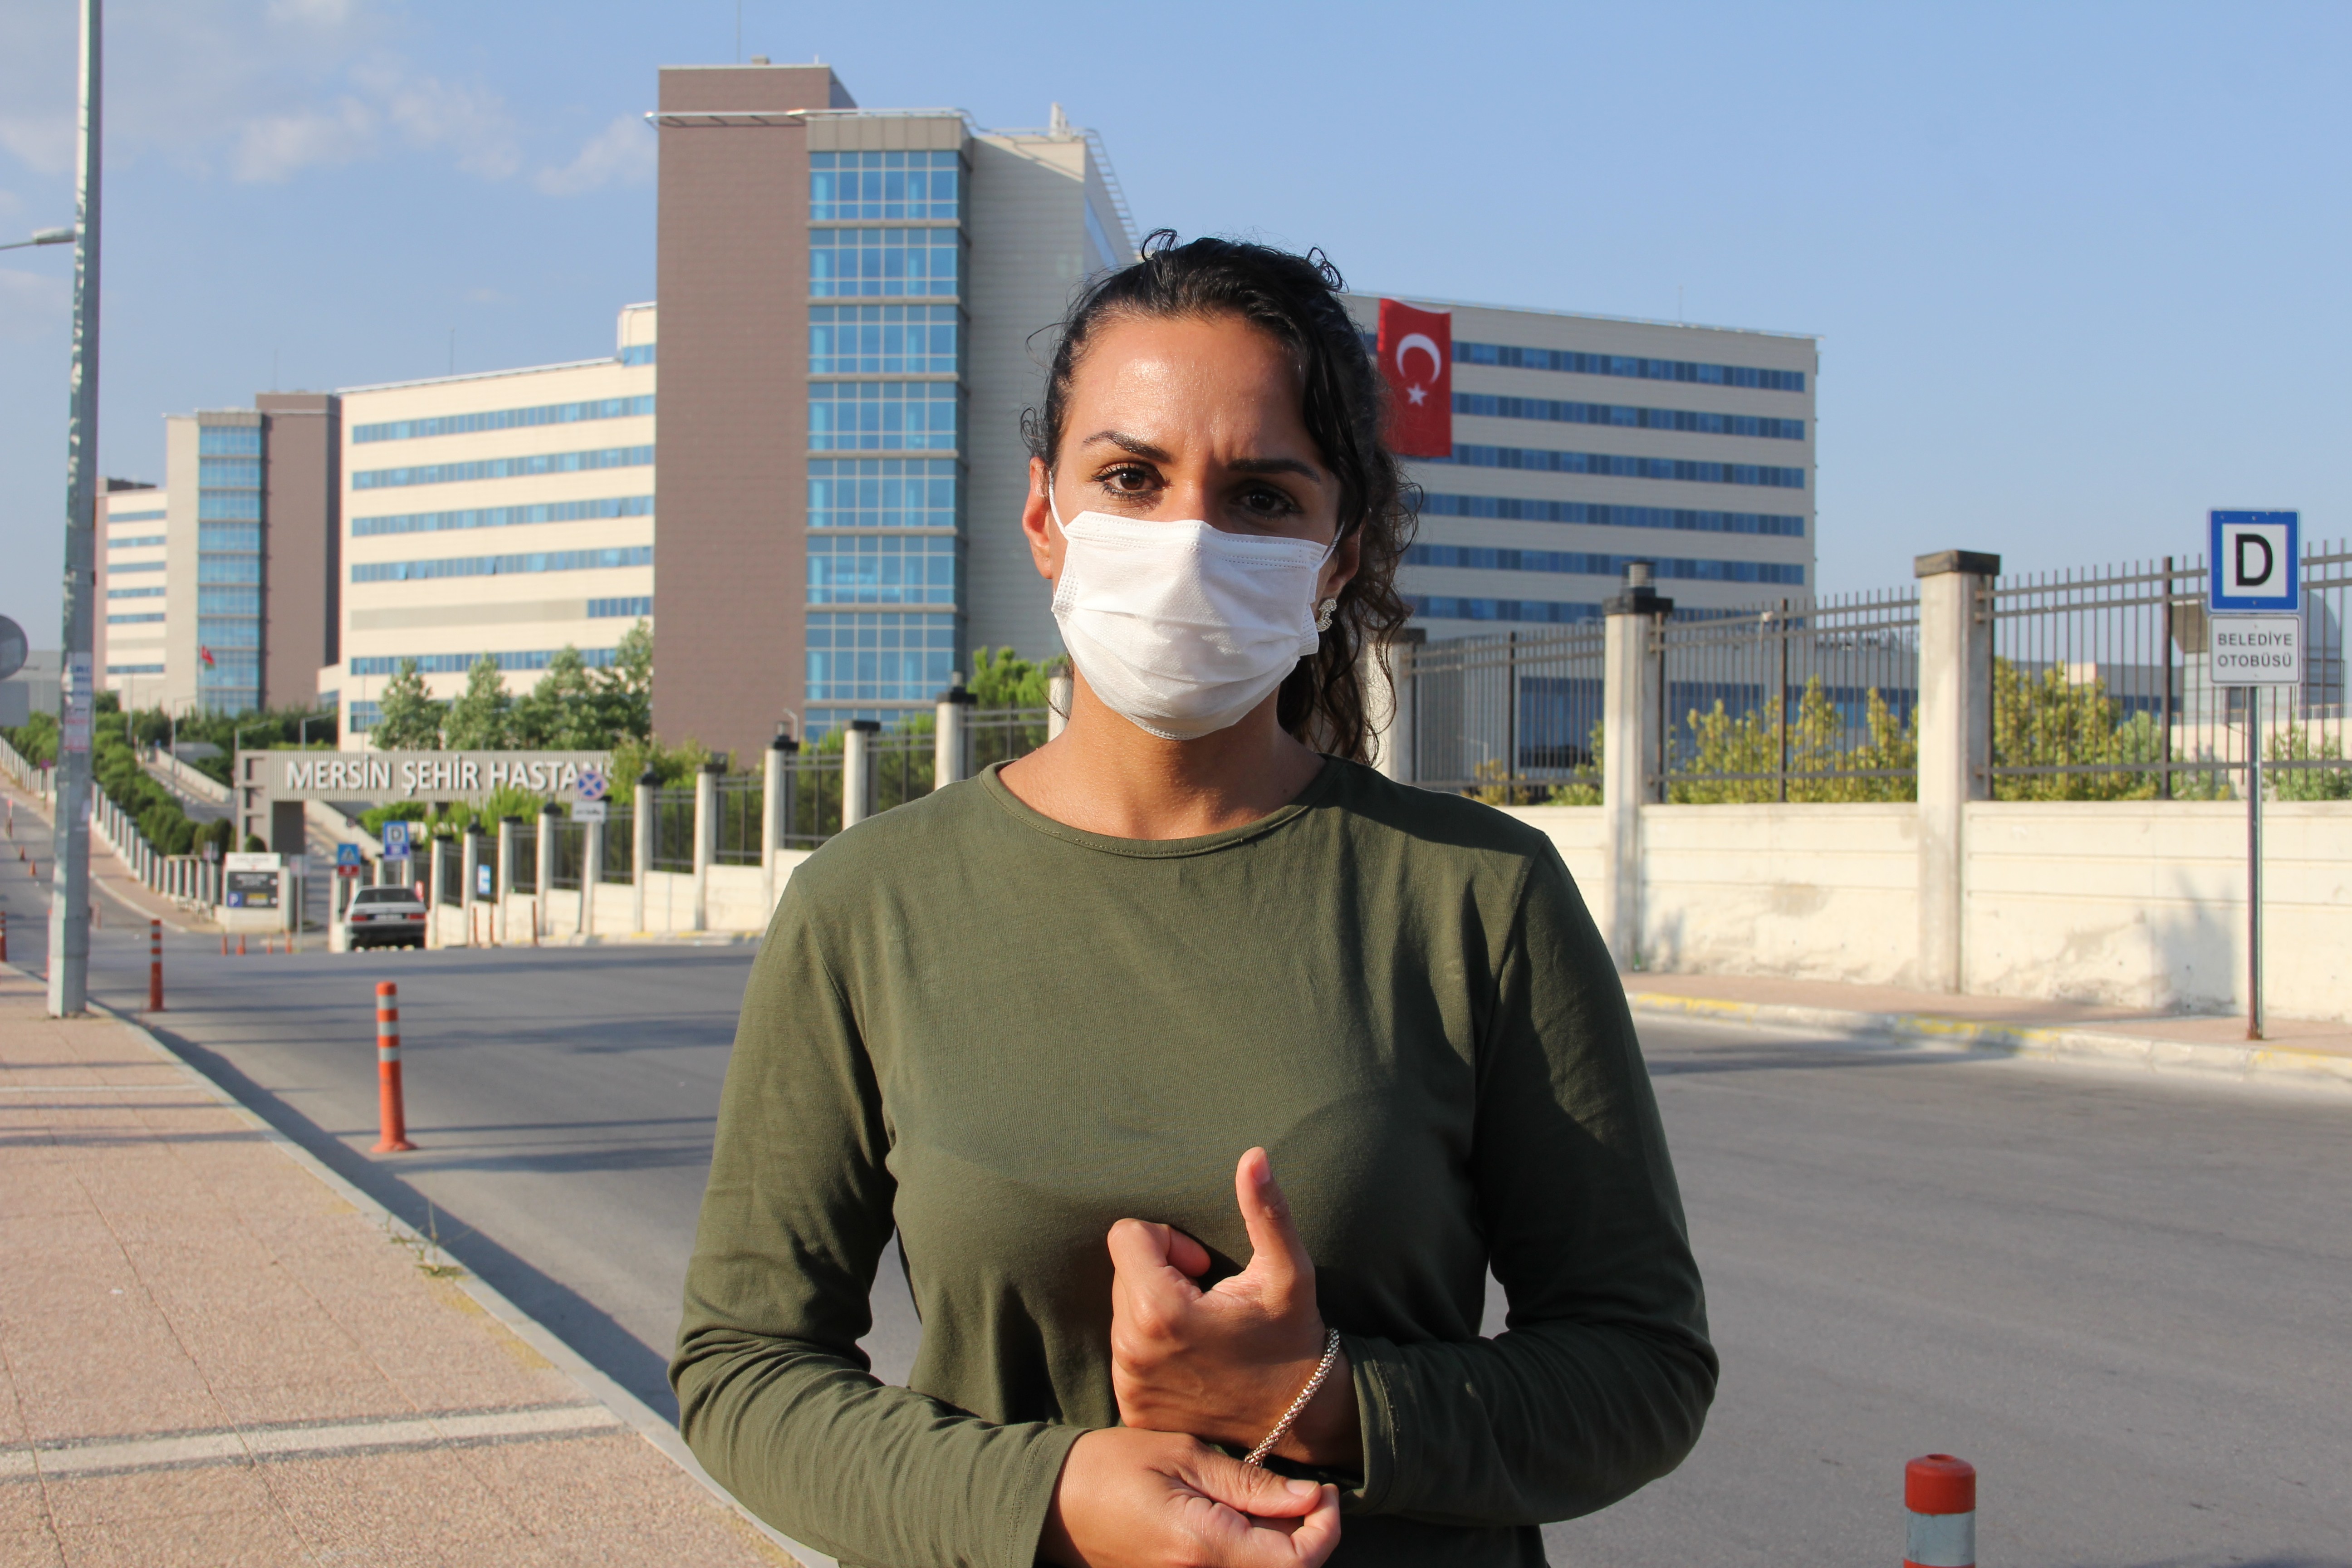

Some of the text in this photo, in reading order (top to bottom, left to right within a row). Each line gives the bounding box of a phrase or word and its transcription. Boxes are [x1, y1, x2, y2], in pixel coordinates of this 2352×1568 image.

[2235, 533, 2274, 587] D
[2218, 631, 2293, 646] BELEDİYE
[2218, 652, 2292, 667] OTOBÜSÜ
[287, 755, 393, 790] MERSİN
[401, 755, 480, 797] ŞEHİR
[391, 826, 402, 842] D
[229, 892, 239, 907] P
